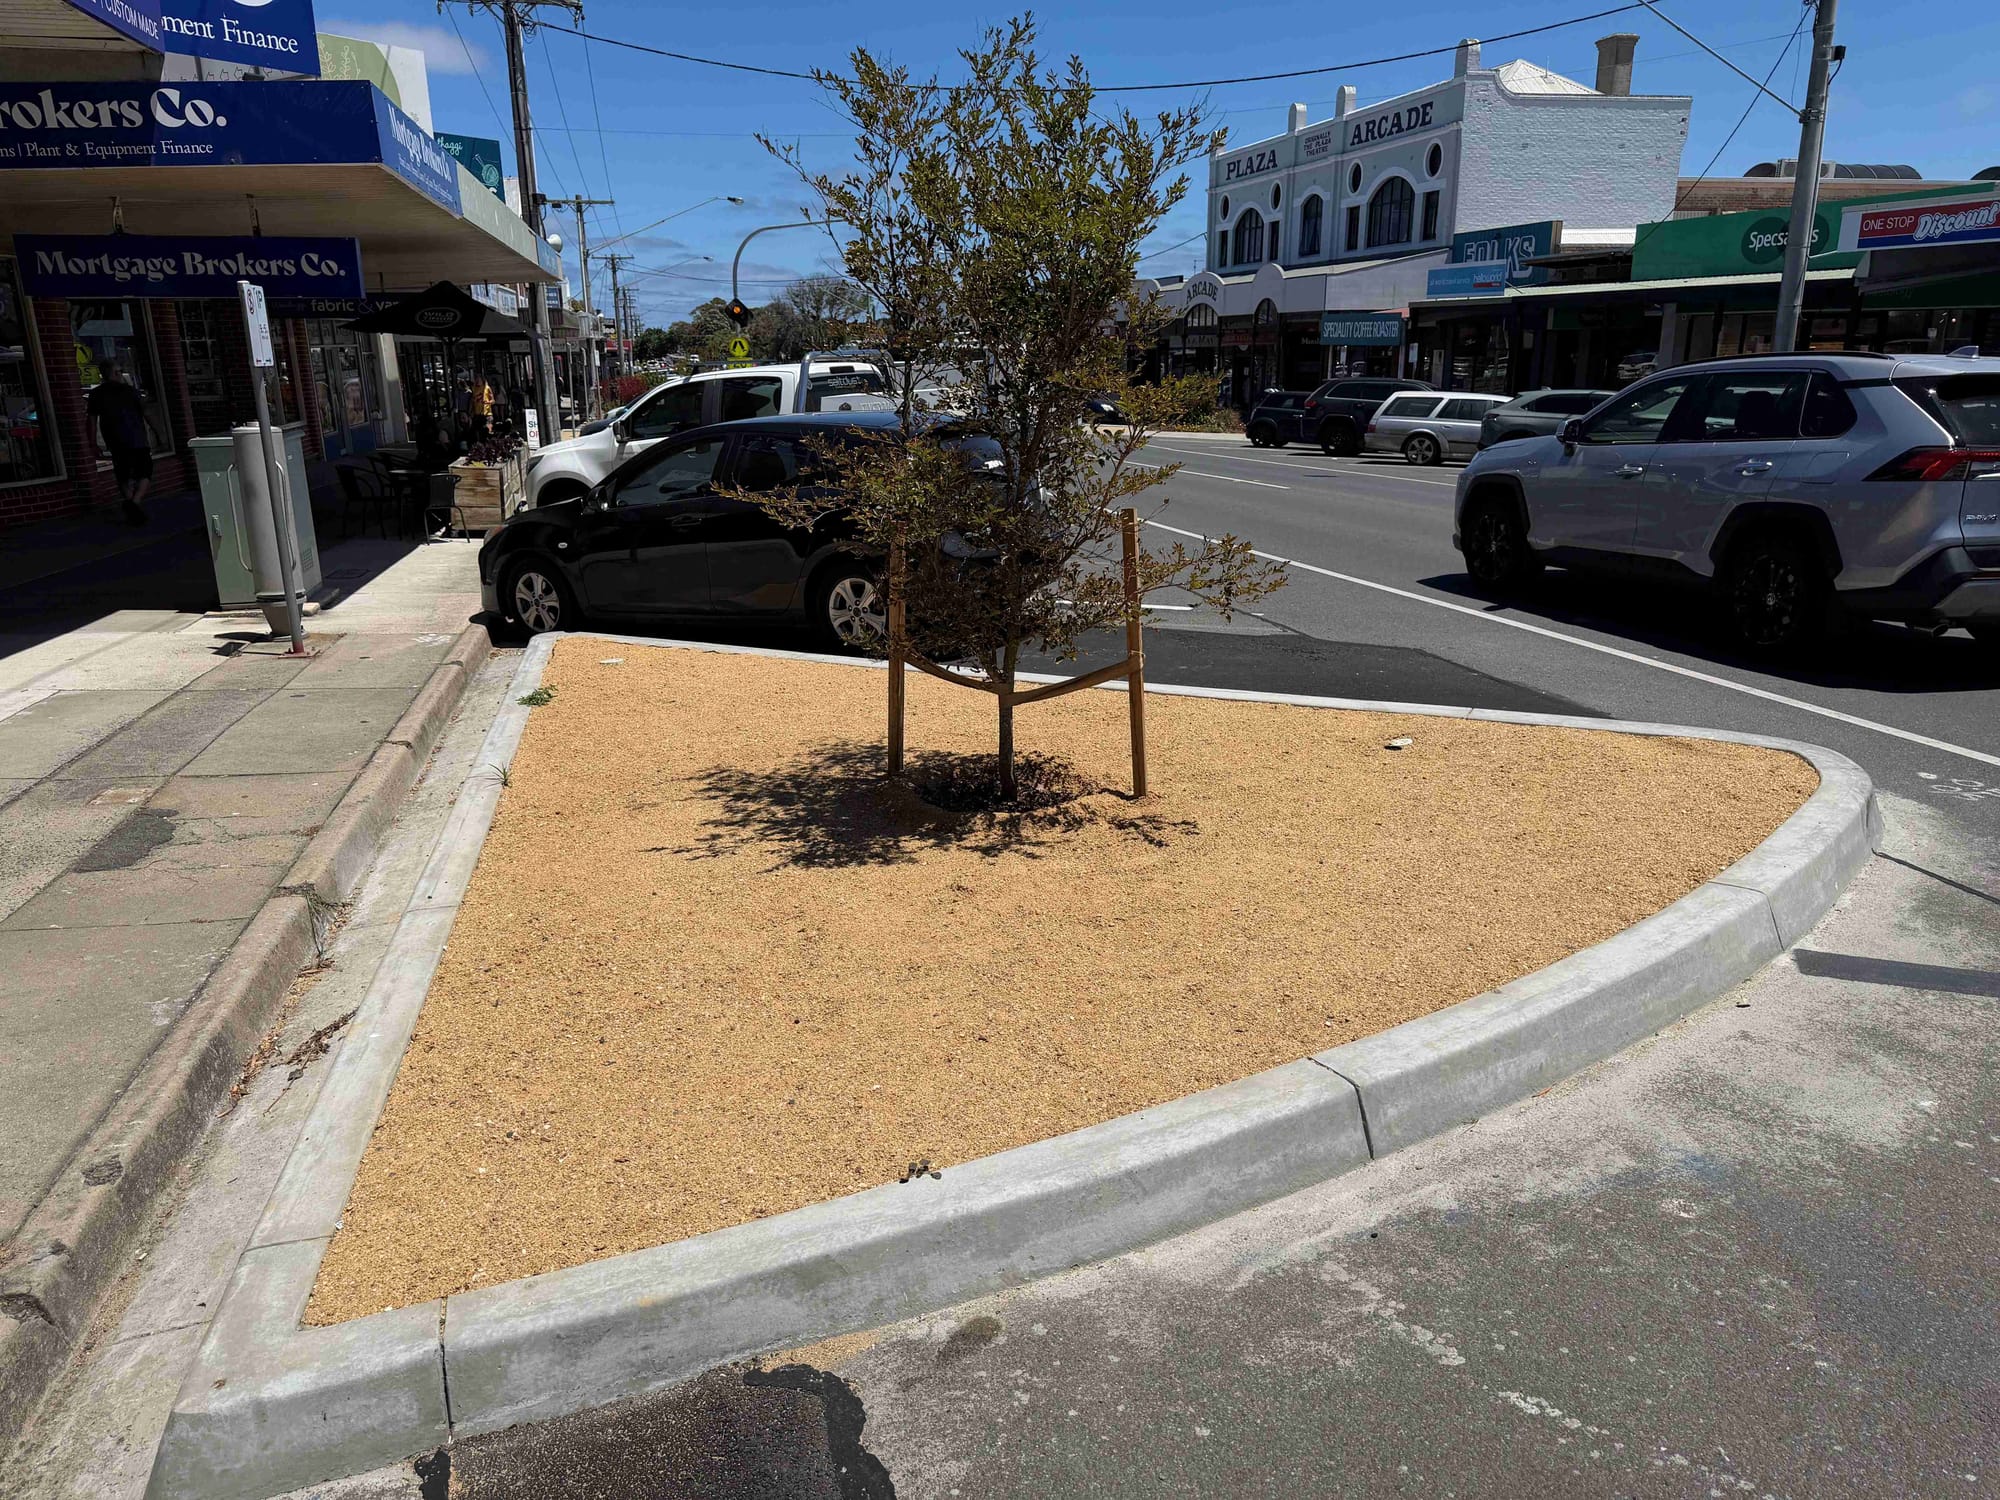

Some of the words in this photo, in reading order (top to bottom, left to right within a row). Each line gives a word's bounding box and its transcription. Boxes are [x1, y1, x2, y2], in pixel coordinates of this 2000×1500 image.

[137, 12, 159, 40] MADE
[161, 15, 216, 39] ment
[220, 14, 299, 54] Finance
[150, 88, 228, 128] Co.
[24, 142, 63, 157] Plant
[66, 143, 80, 156] &
[85, 141, 157, 160] Equipment
[160, 140, 214, 154] Finance
[1225, 149, 1278, 180] PLAZA
[1350, 101, 1434, 146] ARCADE
[1315, 137, 1332, 148] PLAZA
[1863, 218, 1884, 232] ONE
[1887, 215, 1915, 230] STOP
[36, 251, 178, 282] Mortgage
[181, 251, 296, 276] Brokers
[300, 252, 346, 277] Co.
[1186, 281, 1219, 305] ARCADE
[311, 299, 355, 312] fabric
[1373, 320, 1400, 338] ROASTER
